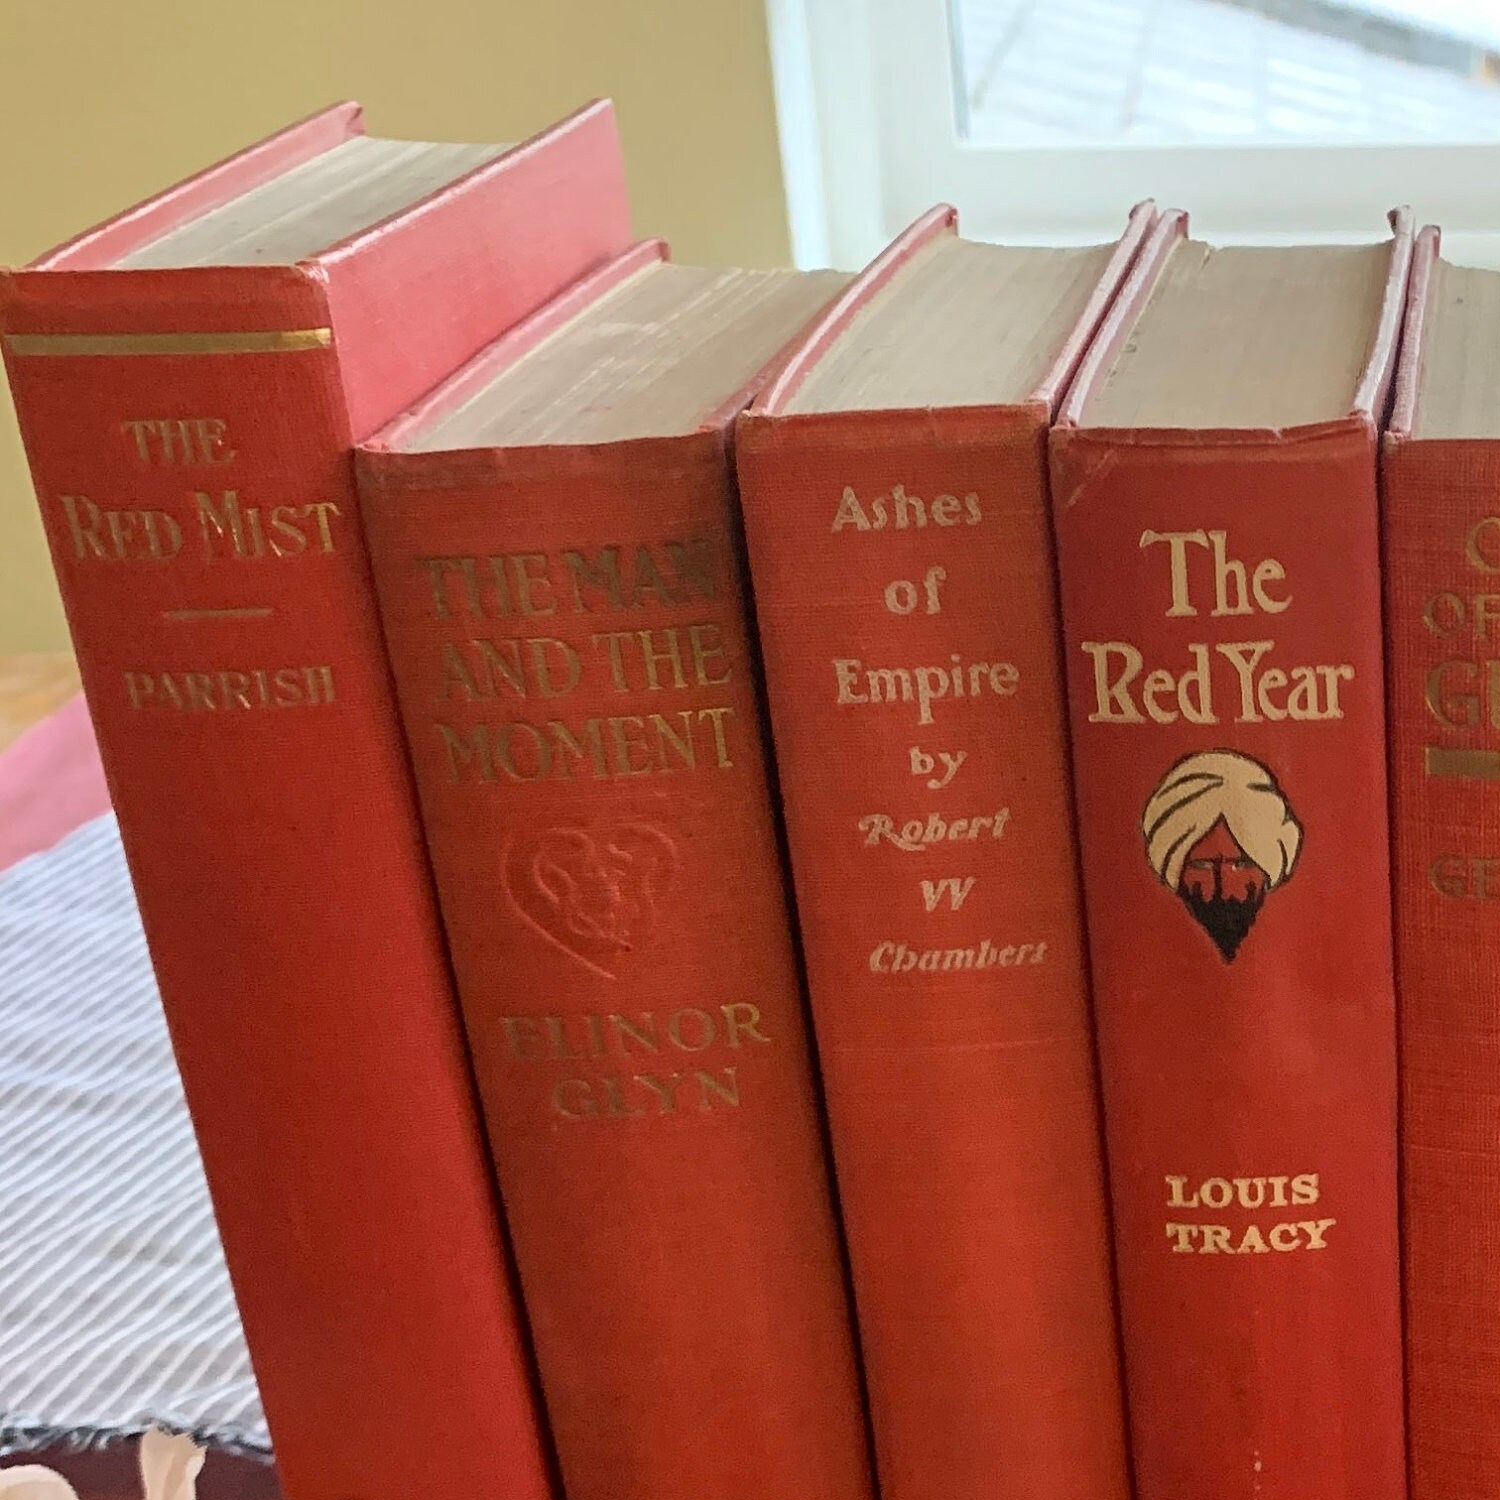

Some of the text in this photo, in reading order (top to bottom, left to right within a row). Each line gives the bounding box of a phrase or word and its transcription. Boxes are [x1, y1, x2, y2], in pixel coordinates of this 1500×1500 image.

[122, 418, 235, 465] THE
[831, 485, 982, 532] Ashes
[415, 554, 555, 620] THE
[884, 567, 947, 616] of
[1138, 529, 1294, 618] The
[124, 666, 337, 712] PARRISH
[435, 624, 734, 703] AND THE
[1081, 639, 1355, 725] Red Year
[833, 654, 1020, 726] Empire
[434, 707, 735, 785] MOMENT
[909, 746, 968, 789] by
[858, 807, 1012, 850] Robert
[502, 1002, 772, 1061] ELINOR
[552, 1066, 744, 1119] GLYN
[1165, 1173, 1320, 1208] LOUIS
[1165, 1217, 1337, 1254] TRACY
